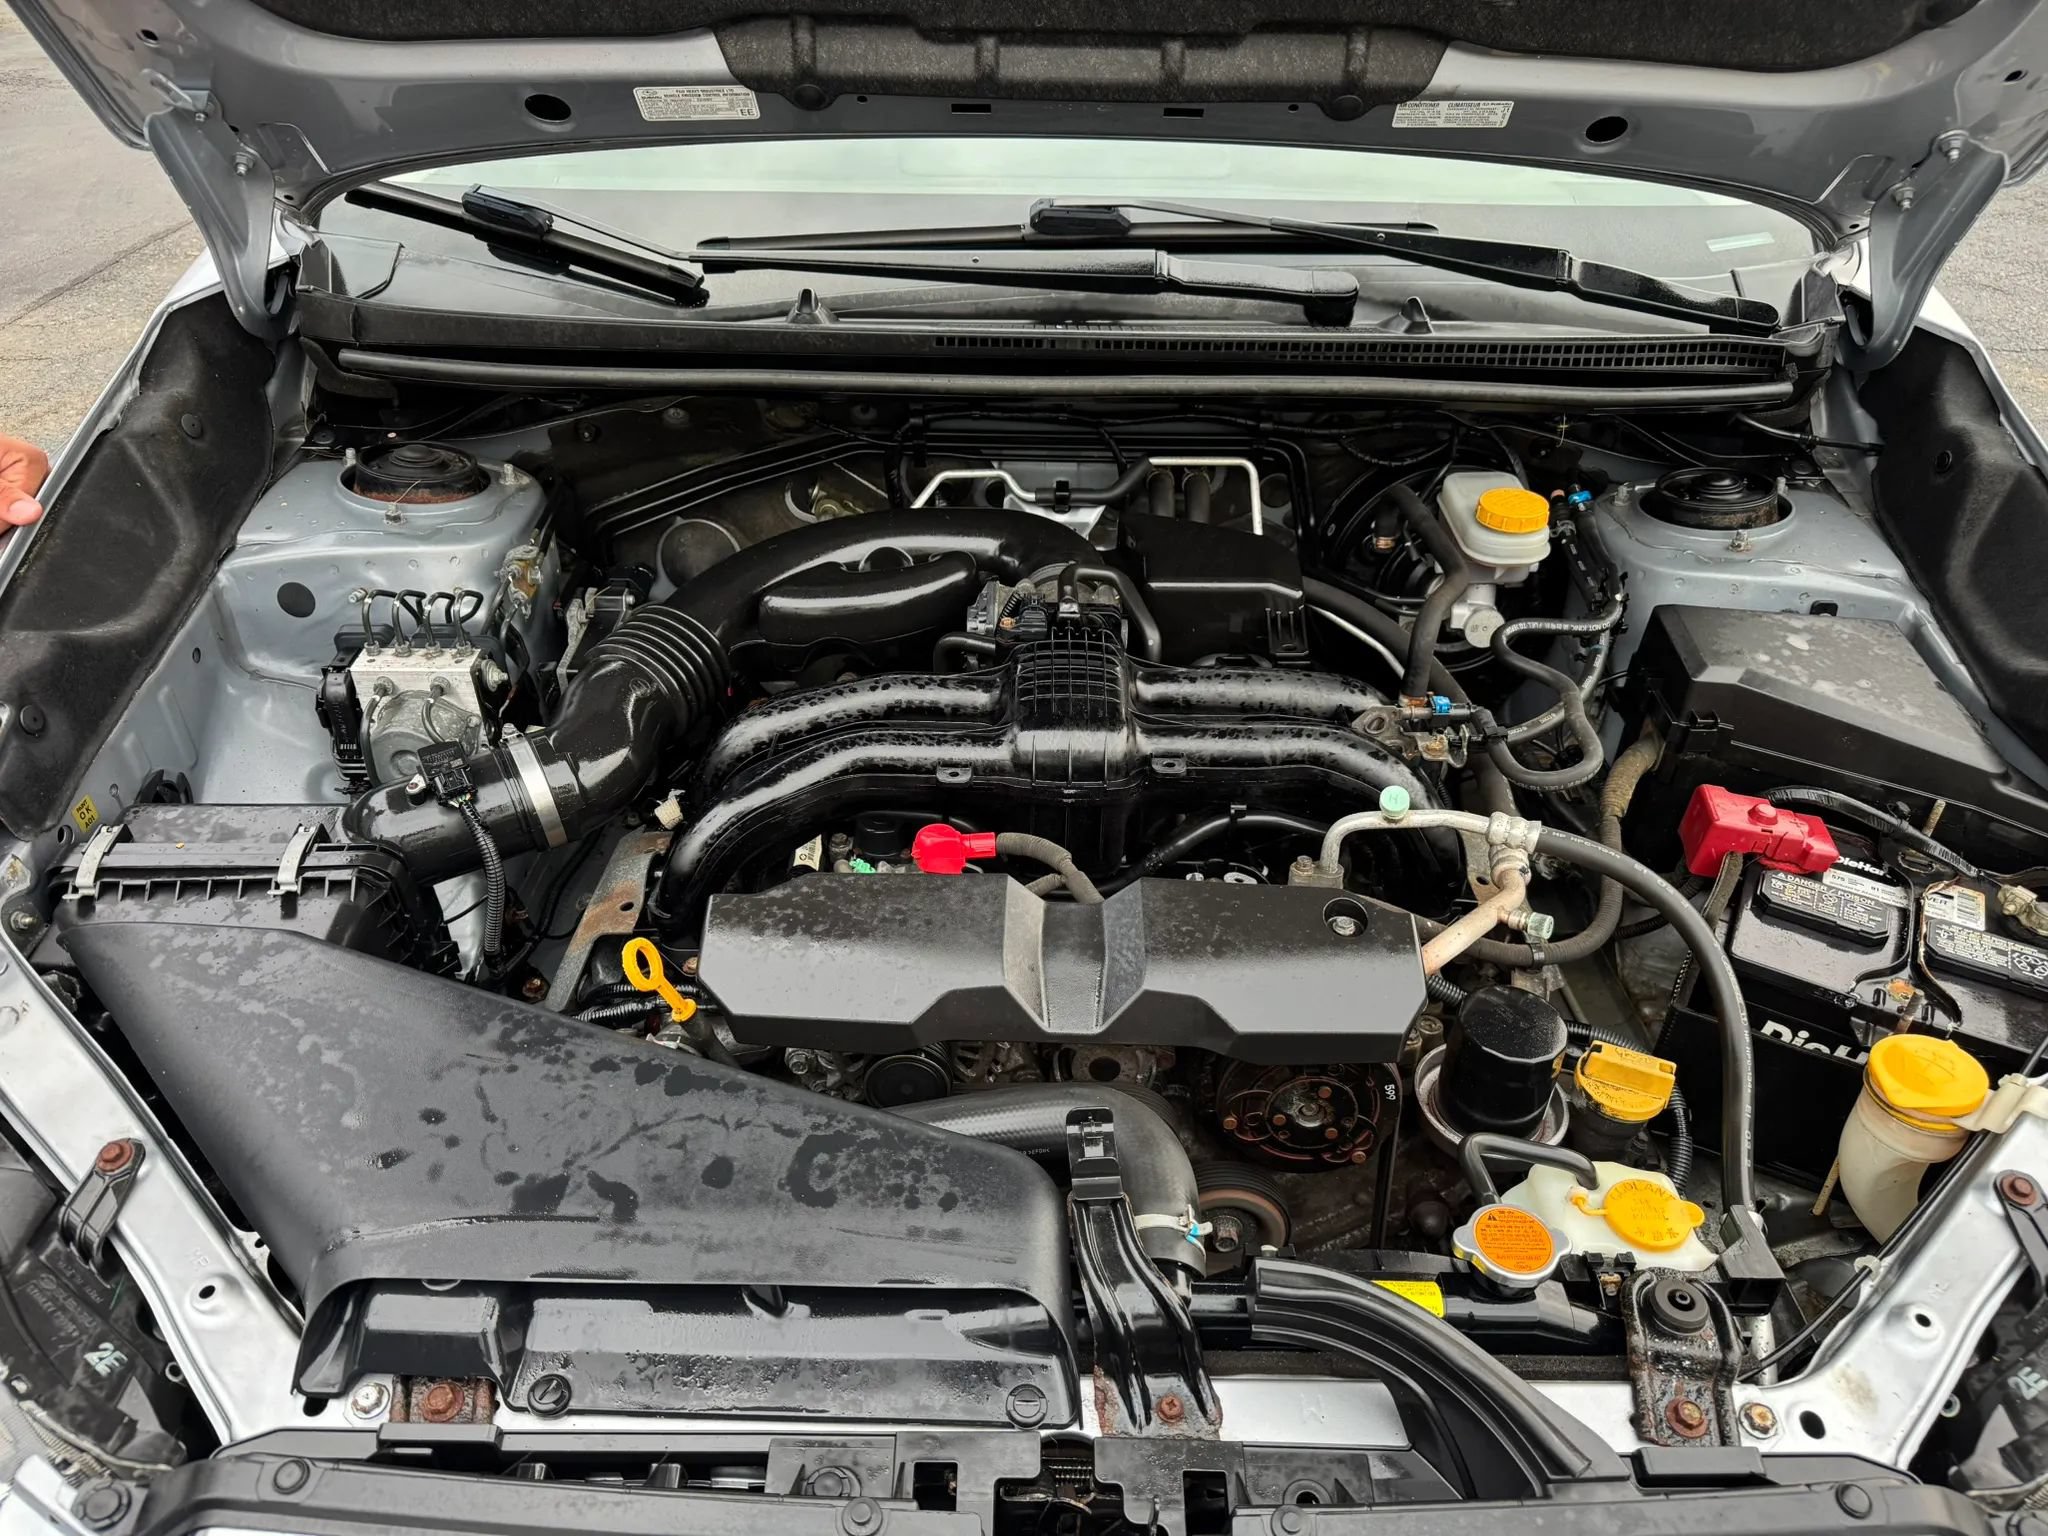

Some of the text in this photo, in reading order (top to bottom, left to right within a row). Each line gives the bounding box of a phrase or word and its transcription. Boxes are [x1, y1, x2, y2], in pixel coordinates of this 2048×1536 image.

[740, 108, 755, 116] EE
[1787, 875, 1827, 893] DANGER
[1837, 890, 1875, 906] POISON
[1384, 1083, 1396, 1101] 599
[83, 1342, 129, 1377] 2E
[2007, 1365, 2048, 1401] 2E
